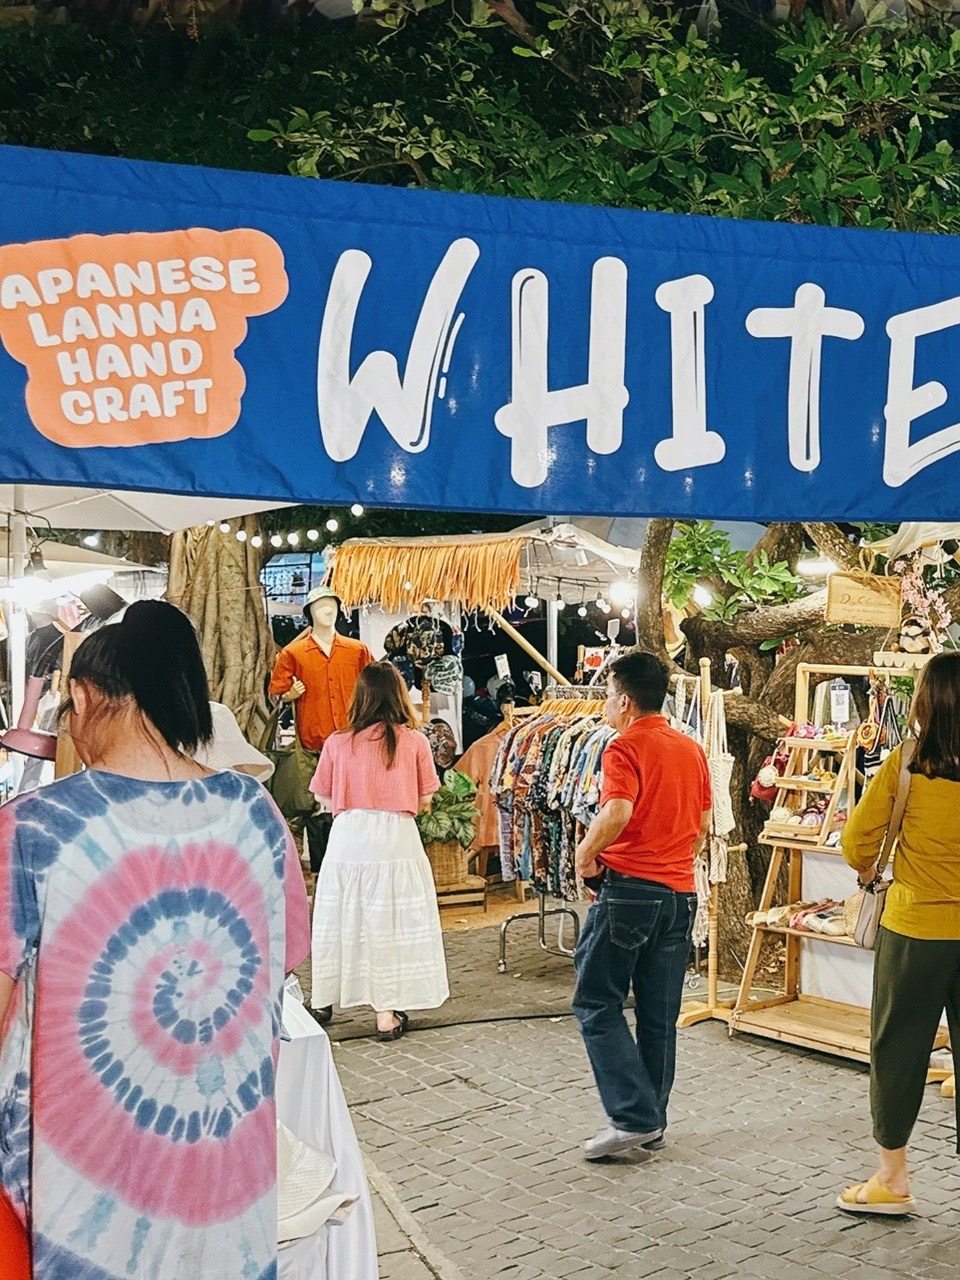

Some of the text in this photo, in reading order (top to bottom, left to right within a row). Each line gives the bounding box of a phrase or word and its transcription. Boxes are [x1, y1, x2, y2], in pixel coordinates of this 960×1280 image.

[0, 256, 261, 310] APANESE
[27, 297, 217, 348] LANNA
[57, 338, 204, 386] HAND
[60, 378, 213, 426] CRAFT
